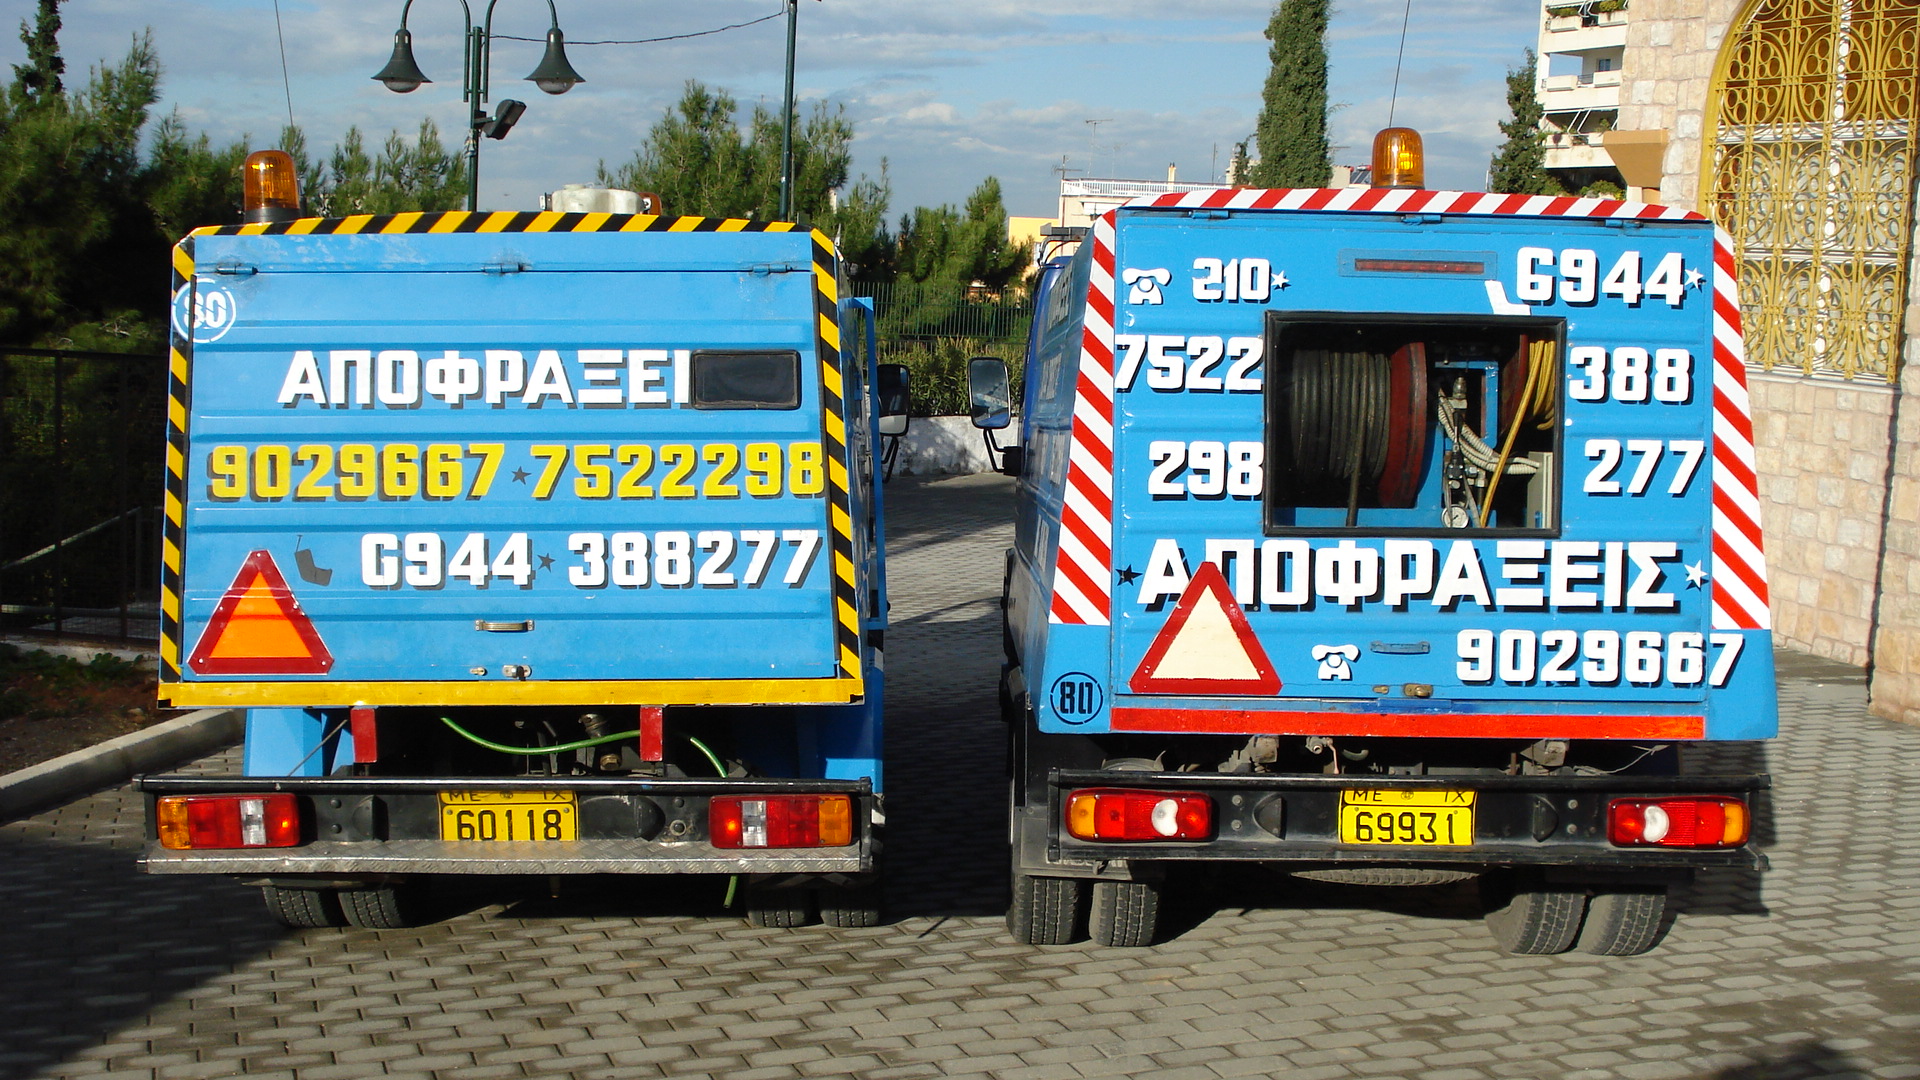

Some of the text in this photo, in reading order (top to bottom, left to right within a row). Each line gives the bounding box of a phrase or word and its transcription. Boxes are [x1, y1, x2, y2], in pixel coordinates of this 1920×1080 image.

[1192, 257, 1270, 300] 210
[1516, 247, 1684, 305] 6944
[183, 291, 227, 328] 80
[1115, 334, 1264, 391] 7522
[1569, 346, 1690, 402] 388
[211, 442, 825, 498] 9029667 7522298
[1148, 441, 1264, 496] 298
[1583, 439, 1705, 494] 277
[567, 530, 819, 587] 388277
[1136, 538, 1678, 609] ΑΠΟΦΡΑΞΕΙΣ
[1456, 628, 1744, 688] 9029667
[1060, 682, 1093, 714] 80
[456, 810, 562, 841] 60118
[1356, 812, 1455, 844] 69931
